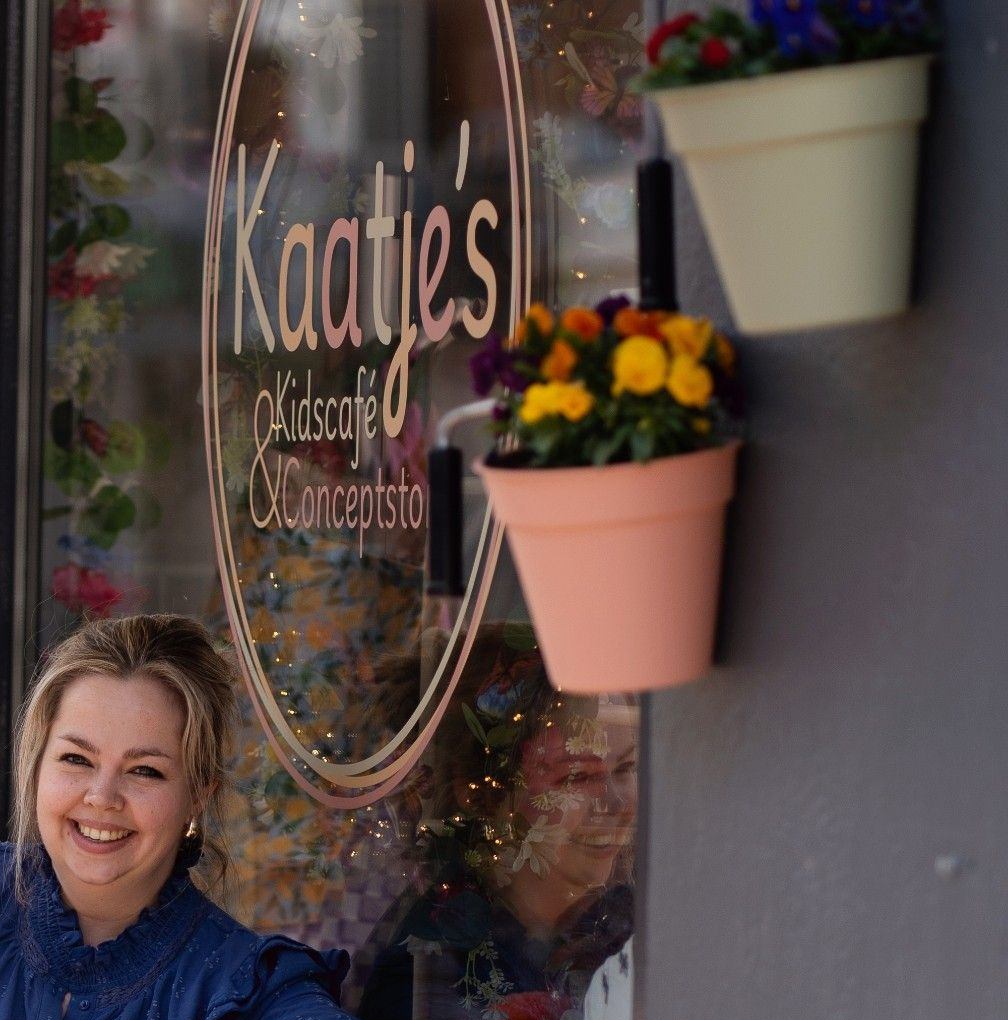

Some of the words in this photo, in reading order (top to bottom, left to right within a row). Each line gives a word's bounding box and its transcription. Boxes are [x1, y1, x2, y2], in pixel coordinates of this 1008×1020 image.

[234, 120, 499, 438] Kaatje's
[250, 389, 282, 529] &
[282, 457, 430, 558] Conceptsto
[276, 366, 378, 470] Kidscafé
